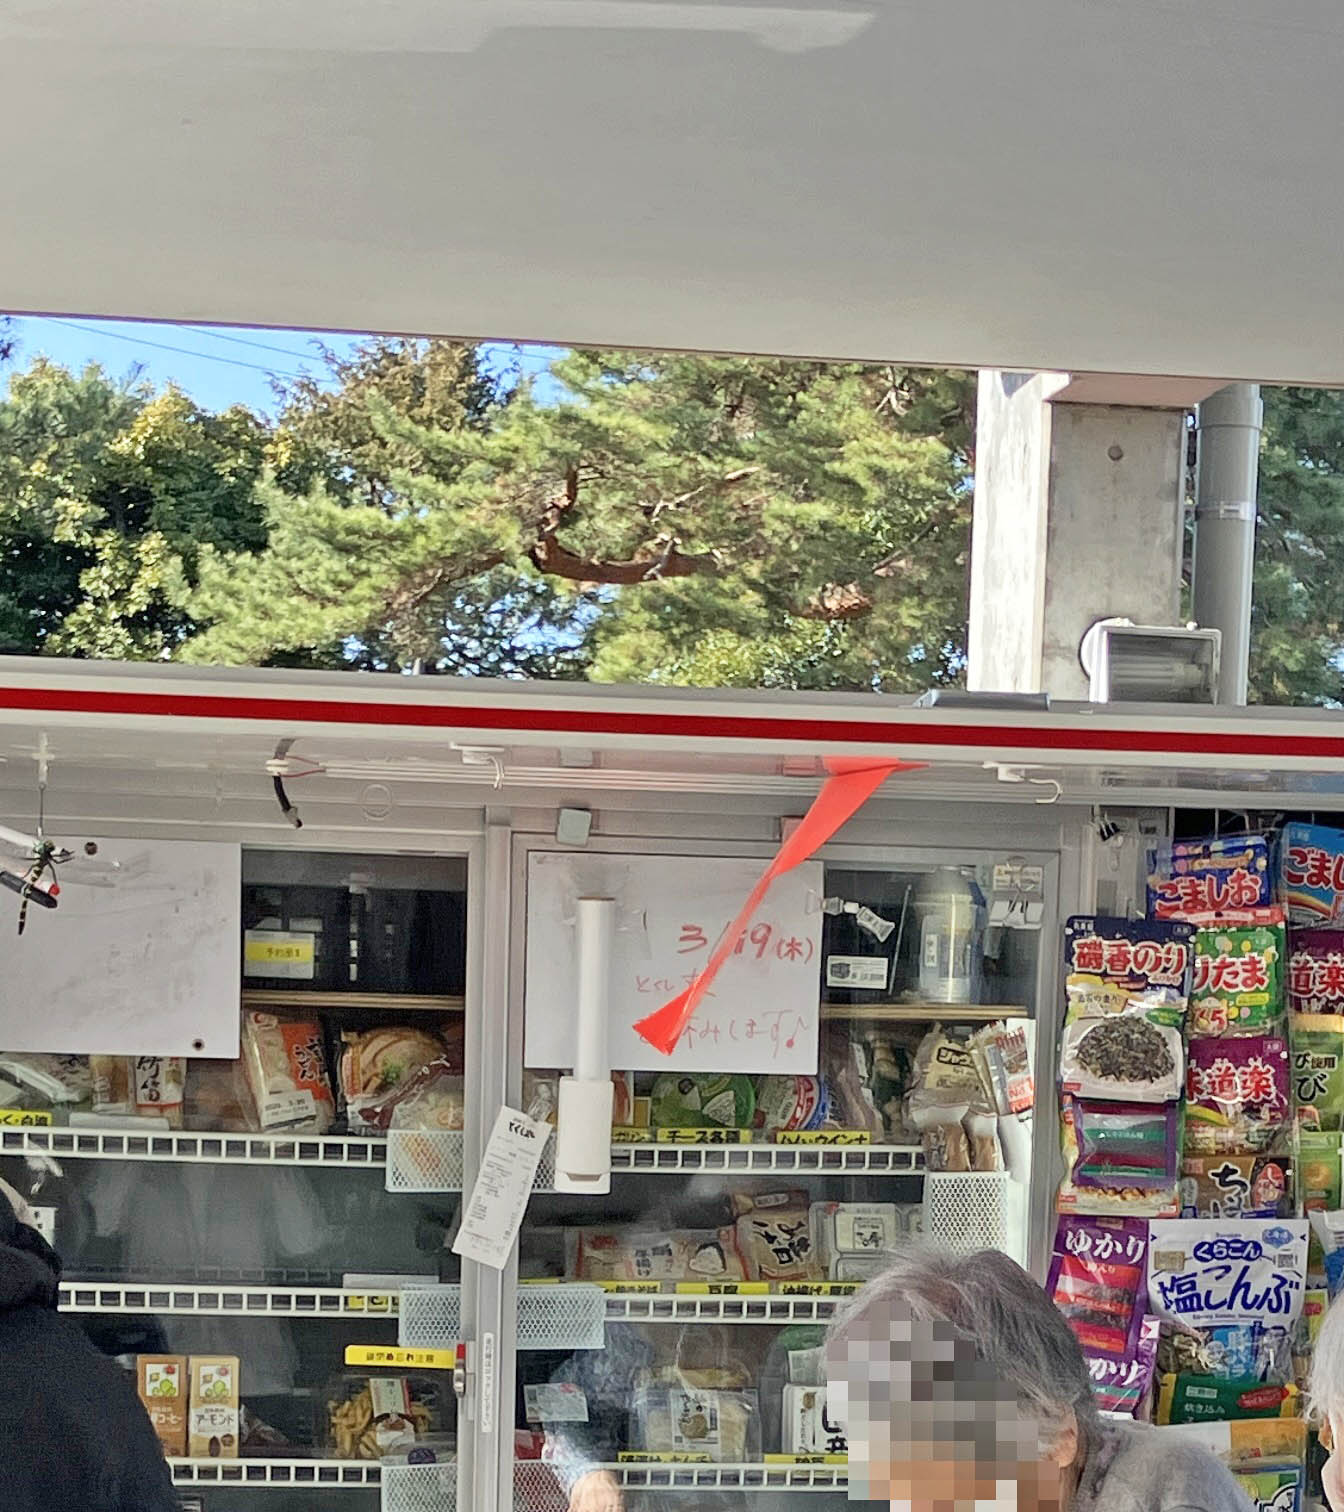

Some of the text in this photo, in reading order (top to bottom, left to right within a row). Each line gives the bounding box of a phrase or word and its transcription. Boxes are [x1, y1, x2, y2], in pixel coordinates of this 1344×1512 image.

[1156, 868, 1262, 912] ごましお
[1074, 938, 1187, 976] 磯香のり
[1193, 954, 1268, 992] りたま
[1295, 1052, 1337, 1070] び使用
[1065, 1228, 1146, 1264] ゆかり
[1195, 1241, 1262, 1261] くらこん
[1158, 1264, 1300, 1314] 塩こんぶ
[1088, 1357, 1148, 1386] かり
